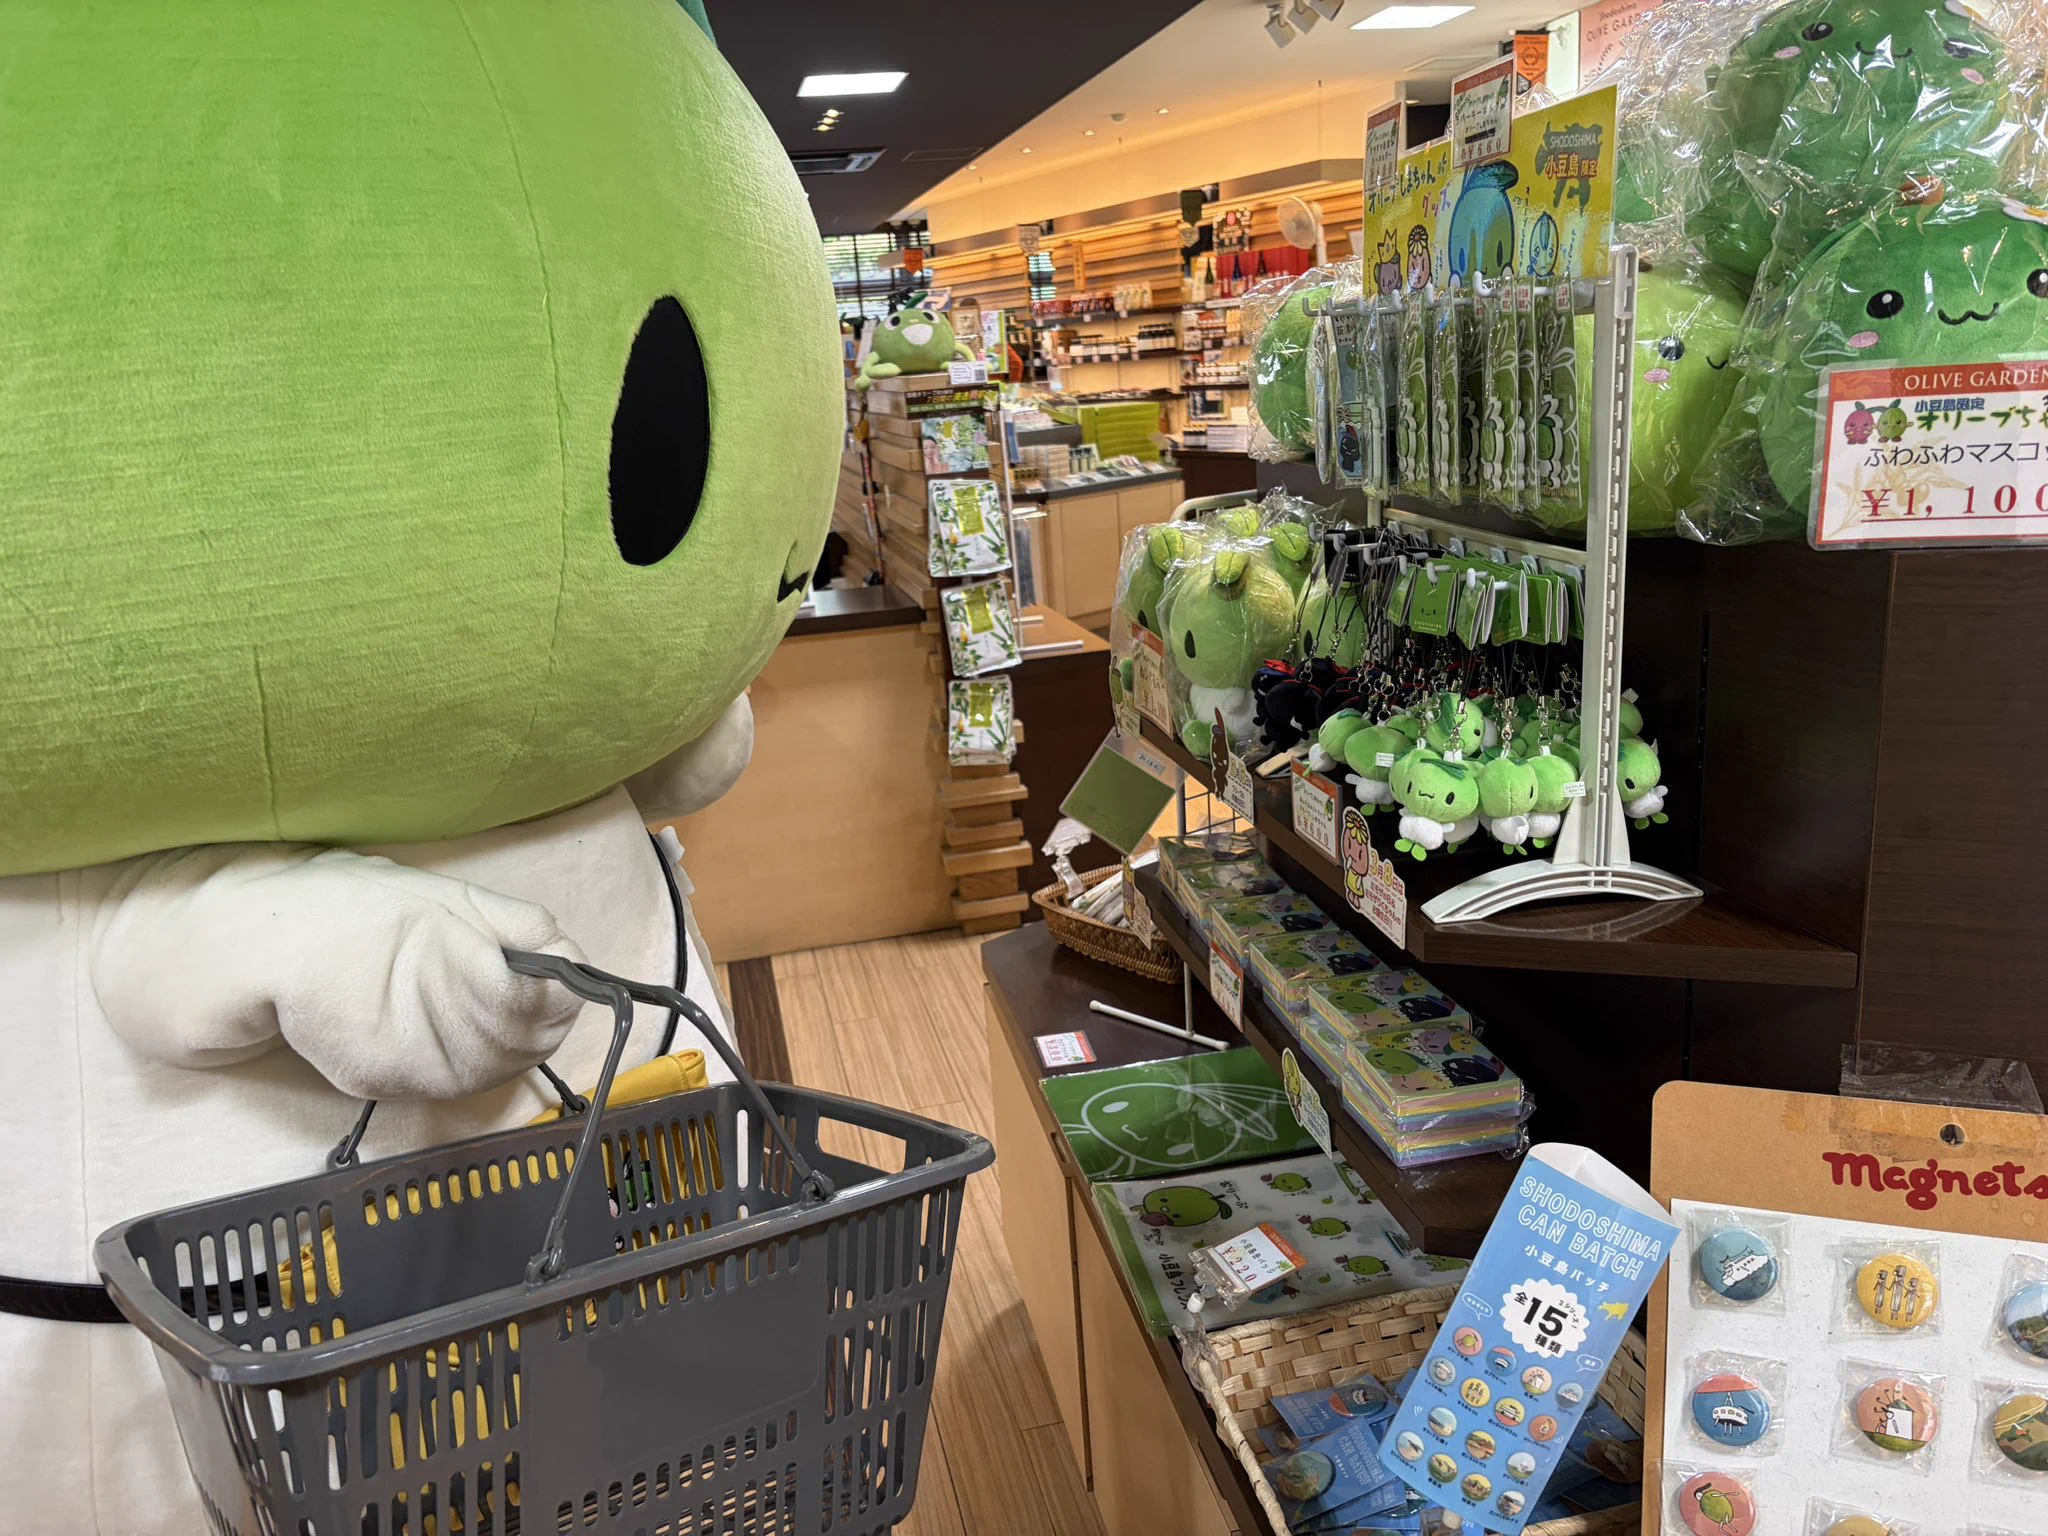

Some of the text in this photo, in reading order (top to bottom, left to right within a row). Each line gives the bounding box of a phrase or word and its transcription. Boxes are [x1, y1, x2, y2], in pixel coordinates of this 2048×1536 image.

[1549, 133, 1597, 149] SHODOSHIMA
[1545, 152, 1579, 180] 小豆島
[1904, 372, 1963, 391] OLIVE
[1914, 397, 1986, 413] 小豆島限定
[1864, 442, 2048, 468] ふわふわマスコ
[1822, 1152, 2048, 1210] Magnets
[1519, 1176, 1662, 1262] SHODOSHIMA
[1518, 1204, 1644, 1281] CAN BATCH
[1221, 1246, 1257, 1282] ¥220
[1524, 1244, 1611, 1292] 小豆島バッチ
[1514, 1291, 1568, 1336] 全 15
[1534, 1333, 1562, 1355] 種類
